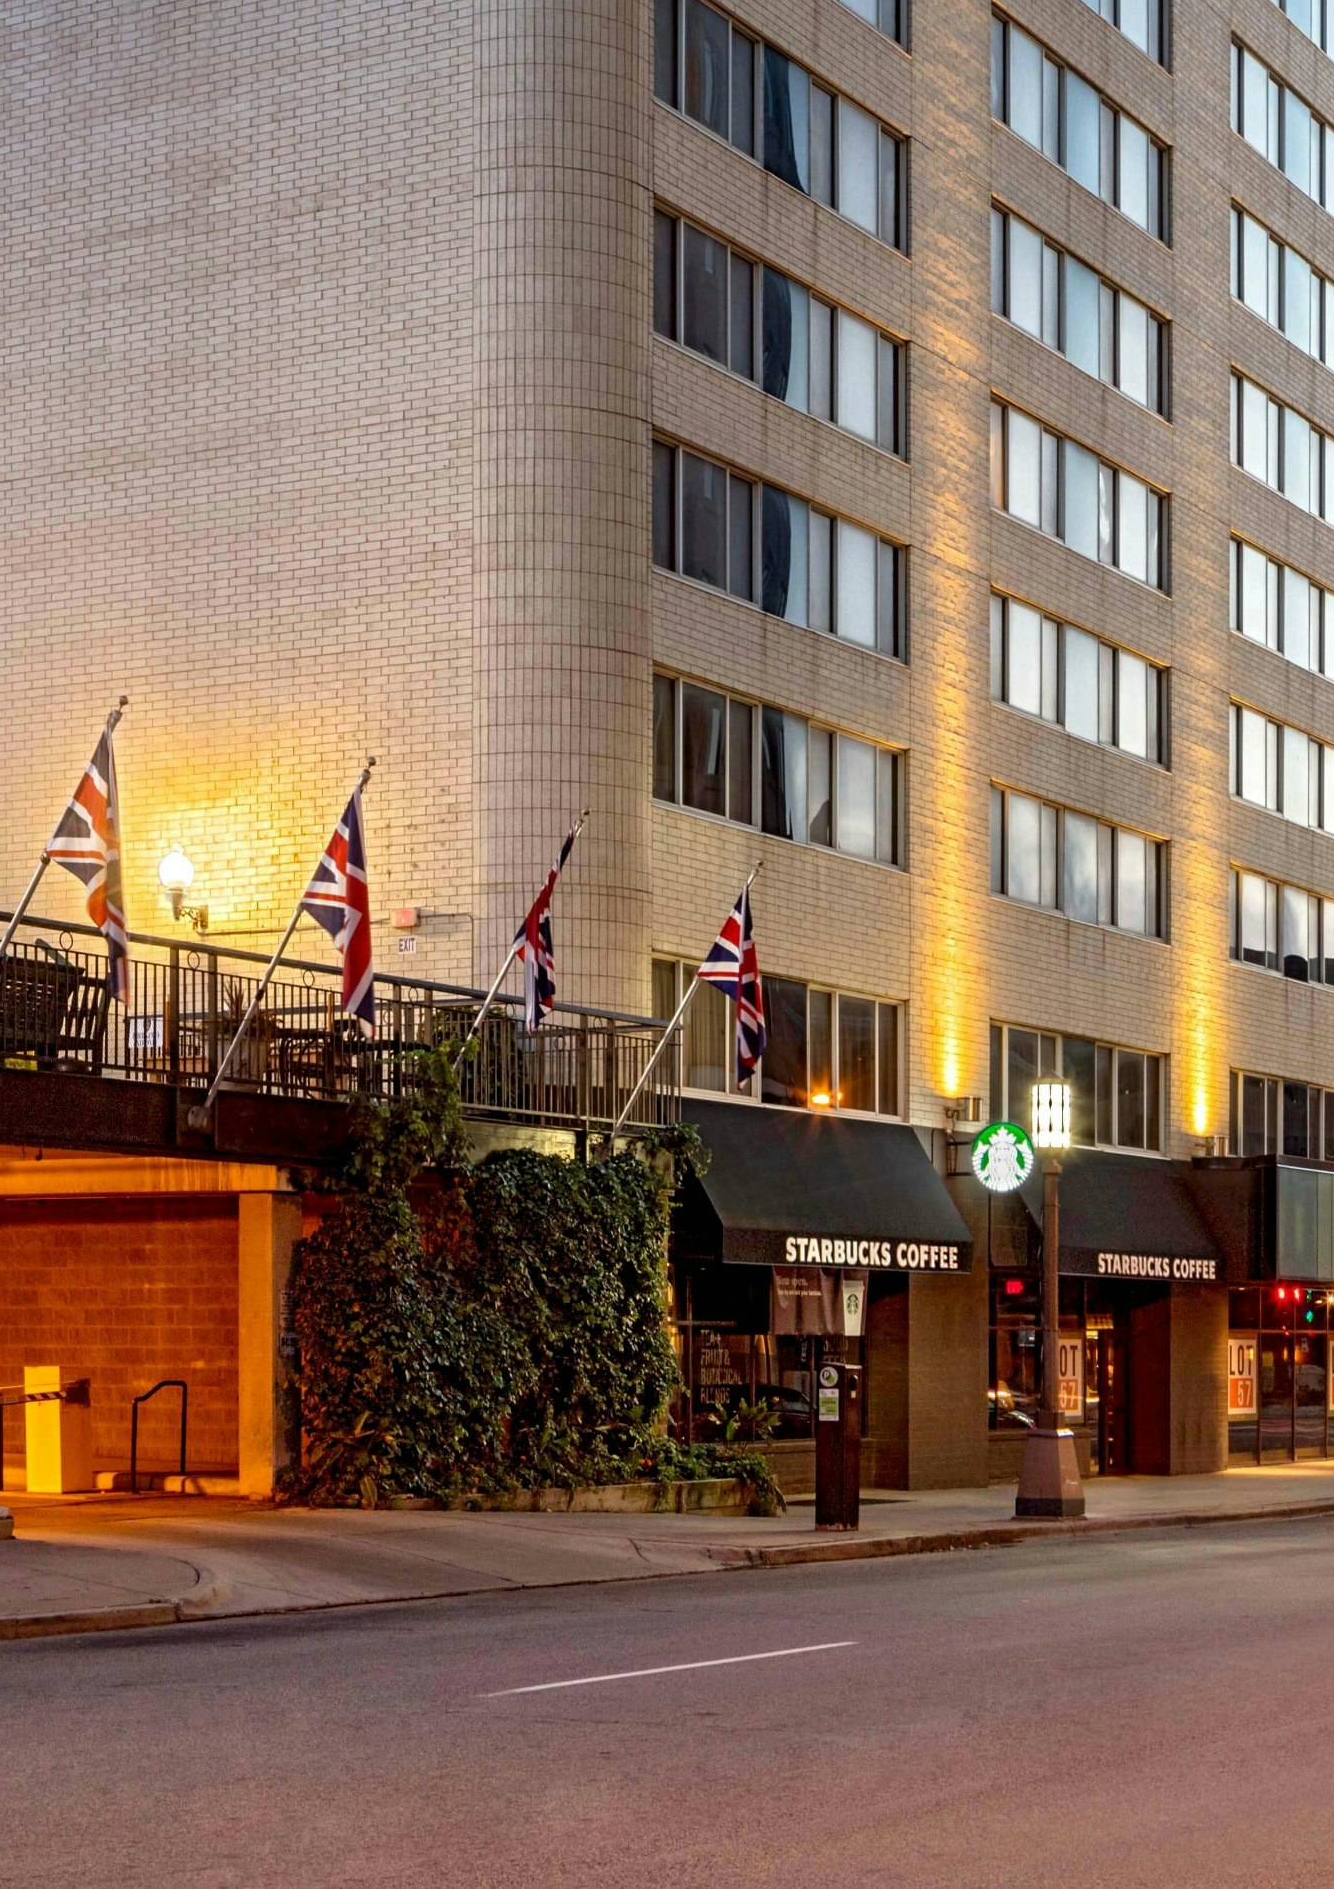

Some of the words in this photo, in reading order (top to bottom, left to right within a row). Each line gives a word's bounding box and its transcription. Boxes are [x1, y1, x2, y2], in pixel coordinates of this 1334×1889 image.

[398, 937, 415, 952] EXIT
[785, 1236, 891, 1267] STARBUCKS
[896, 1243, 959, 1269] COFFEE
[1097, 1252, 1170, 1277] STARBUCKS
[1172, 1258, 1216, 1280] COFFEE
[1059, 1345, 1078, 1377] OT
[1229, 1345, 1253, 1375] LOT
[1060, 1381, 1076, 1409] 57
[1237, 1380, 1251, 1406] 57
